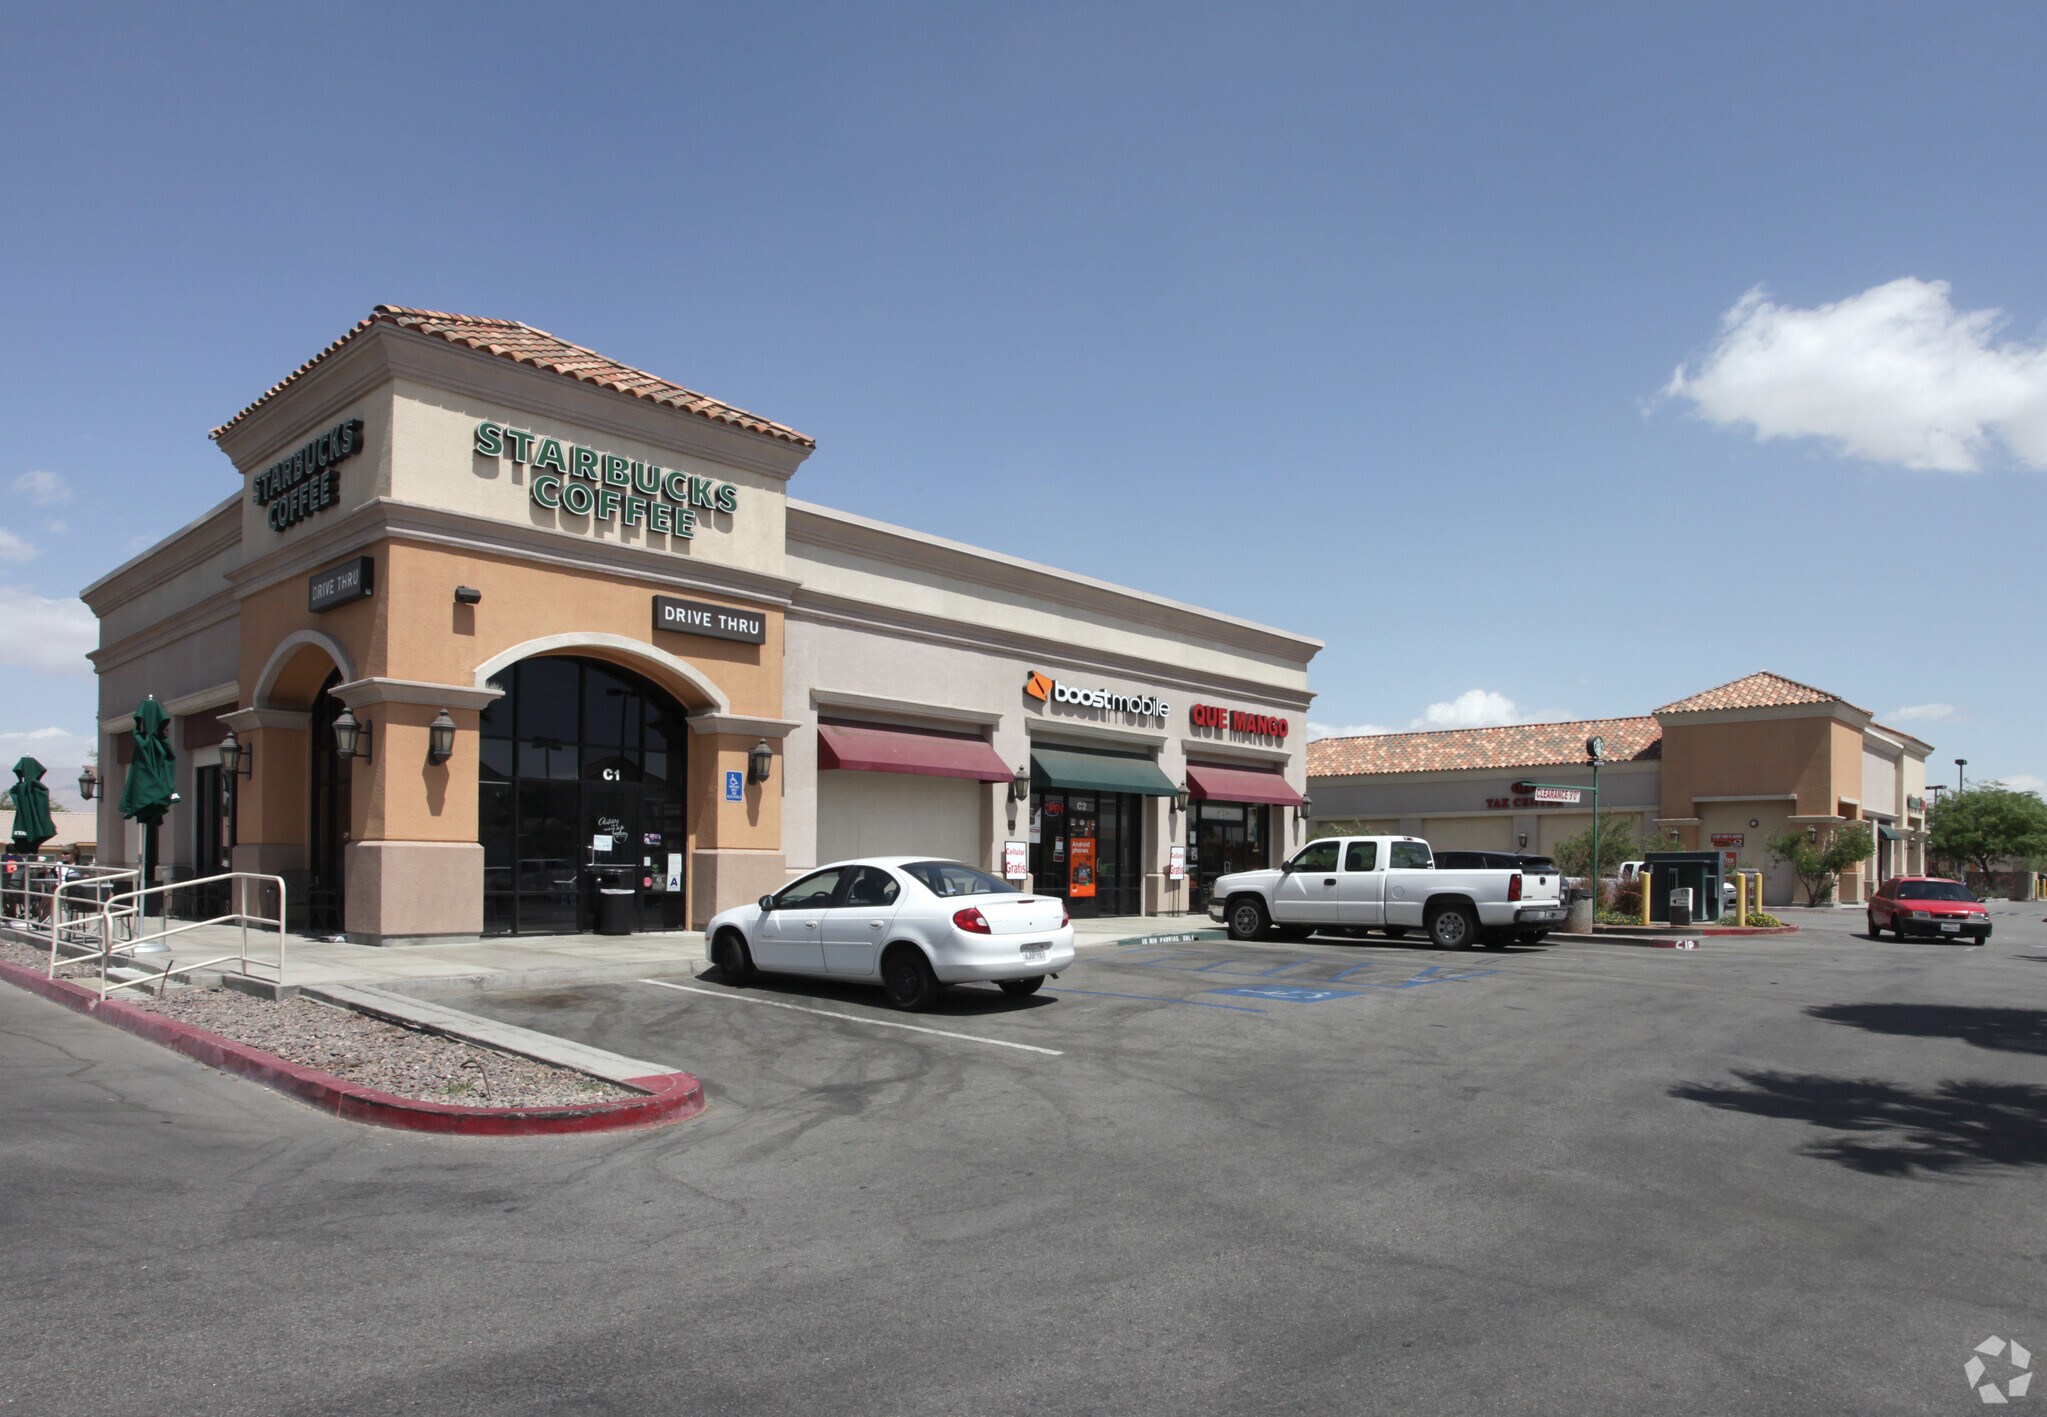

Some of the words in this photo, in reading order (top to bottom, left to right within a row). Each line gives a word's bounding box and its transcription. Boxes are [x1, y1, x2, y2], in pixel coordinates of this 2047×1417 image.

[252, 418, 359, 506] STARBUCKS
[475, 421, 738, 514] STARBUCKS
[268, 470, 335, 531] COFFEE
[531, 475, 695, 539] COFFEE
[312, 579, 335, 600] DRIVE
[337, 569, 359, 591] THRU
[664, 606, 712, 627] DRIVE
[718, 614, 759, 634] THRU
[1192, 703, 1228, 729] QUE
[1232, 710, 1289, 737] MANGO
[602, 768, 621, 781] C1
[1486, 798, 1510, 808] TAX
[1536, 787, 1568, 800] CLEARANCE
[1076, 802, 1087, 811] C2
[1006, 847, 1025, 856] Cellular
[1006, 861, 1026, 874] Gratis
[1170, 864, 1183, 875] Gratis
